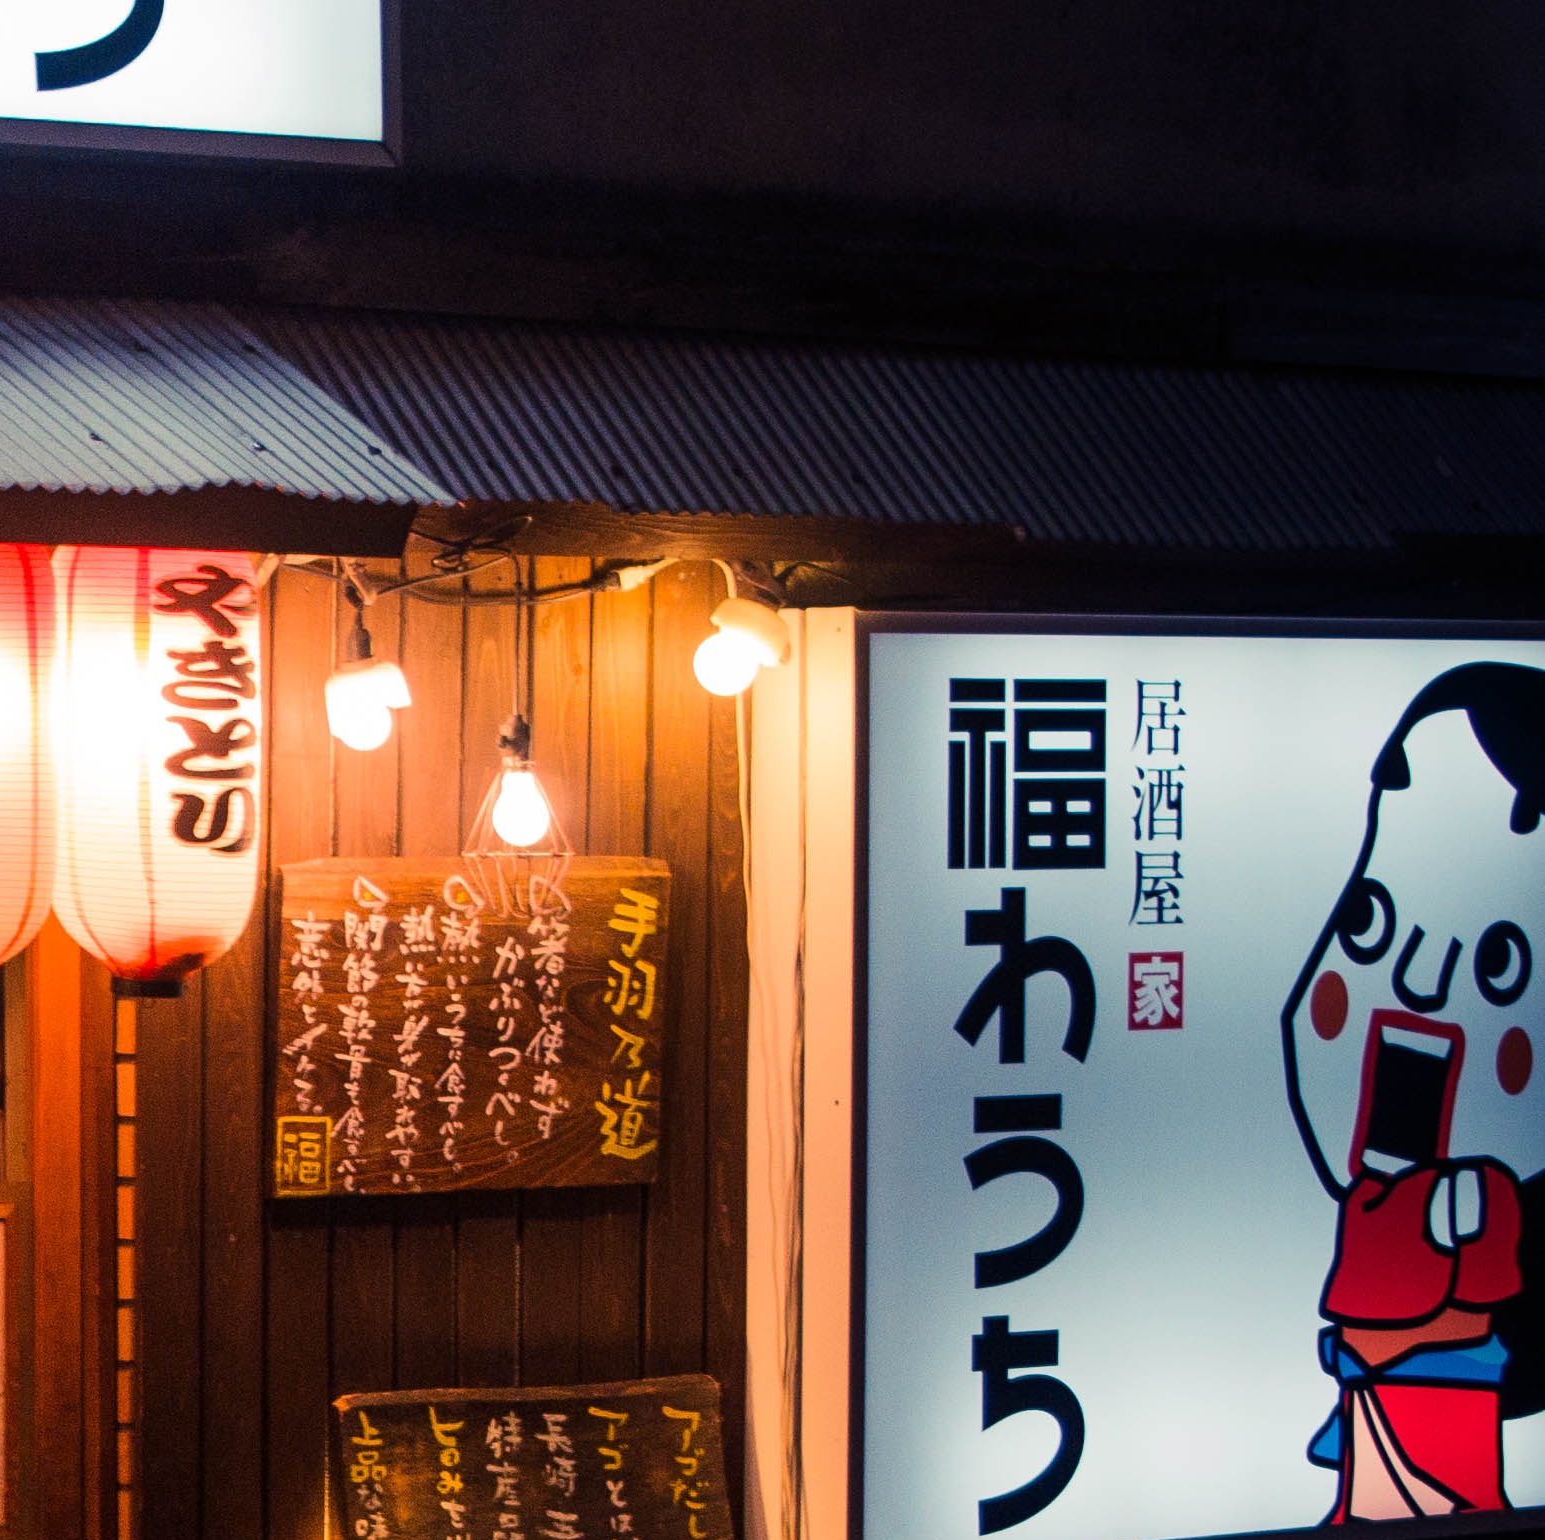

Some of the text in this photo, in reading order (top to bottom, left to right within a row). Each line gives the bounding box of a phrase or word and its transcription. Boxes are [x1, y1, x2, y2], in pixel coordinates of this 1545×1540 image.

[155, 564, 257, 854] やきとり
[1128, 677, 1189, 928] 居酒屋
[594, 887, 660, 1160] 手羽乃道
[947, 677, 1107, 1537] 福わうち
[1132, 955, 1183, 1027] 家
[284, 1132, 321, 1184] 福
